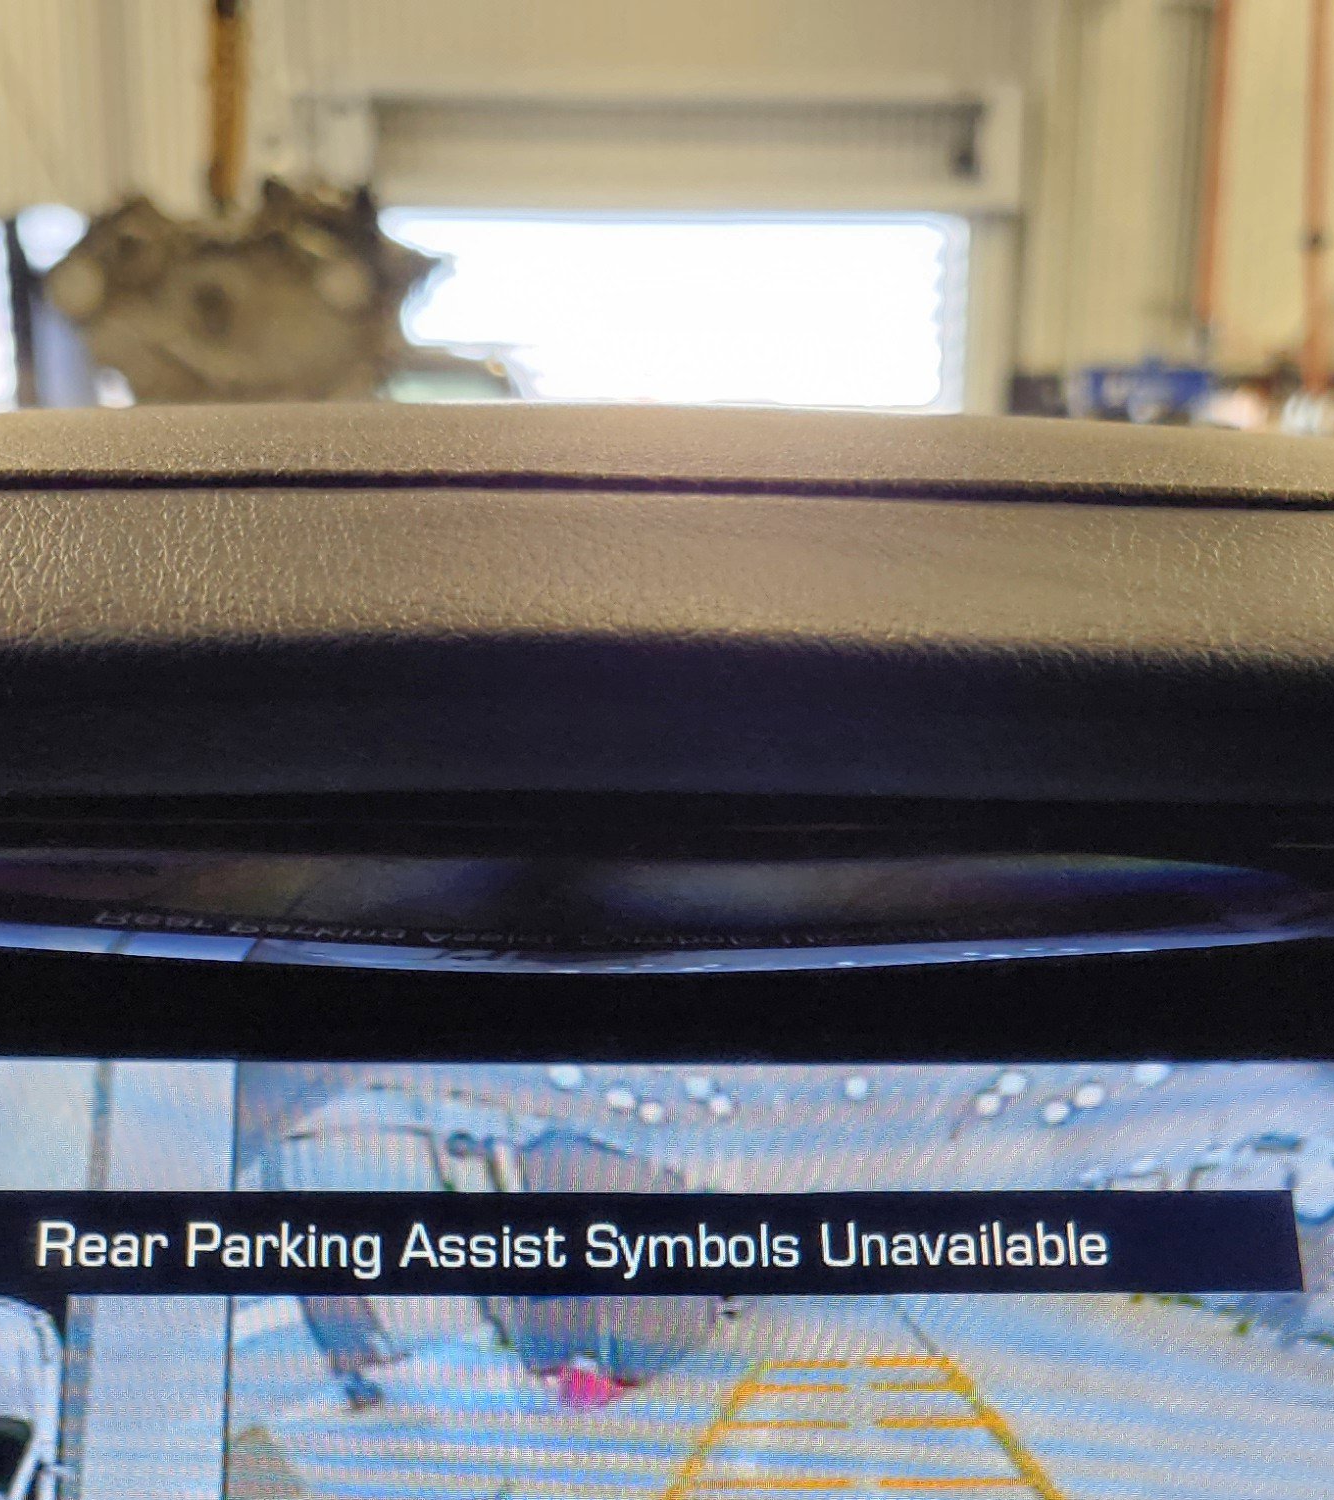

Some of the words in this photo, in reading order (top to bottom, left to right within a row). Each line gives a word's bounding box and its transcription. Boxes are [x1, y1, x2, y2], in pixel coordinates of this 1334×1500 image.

[36, 1219, 170, 1269] Rear
[186, 1220, 382, 1281] Parking
[398, 1221, 568, 1269] Assist
[584, 1221, 800, 1280] Symbols
[819, 1220, 1109, 1269] Unavailable
